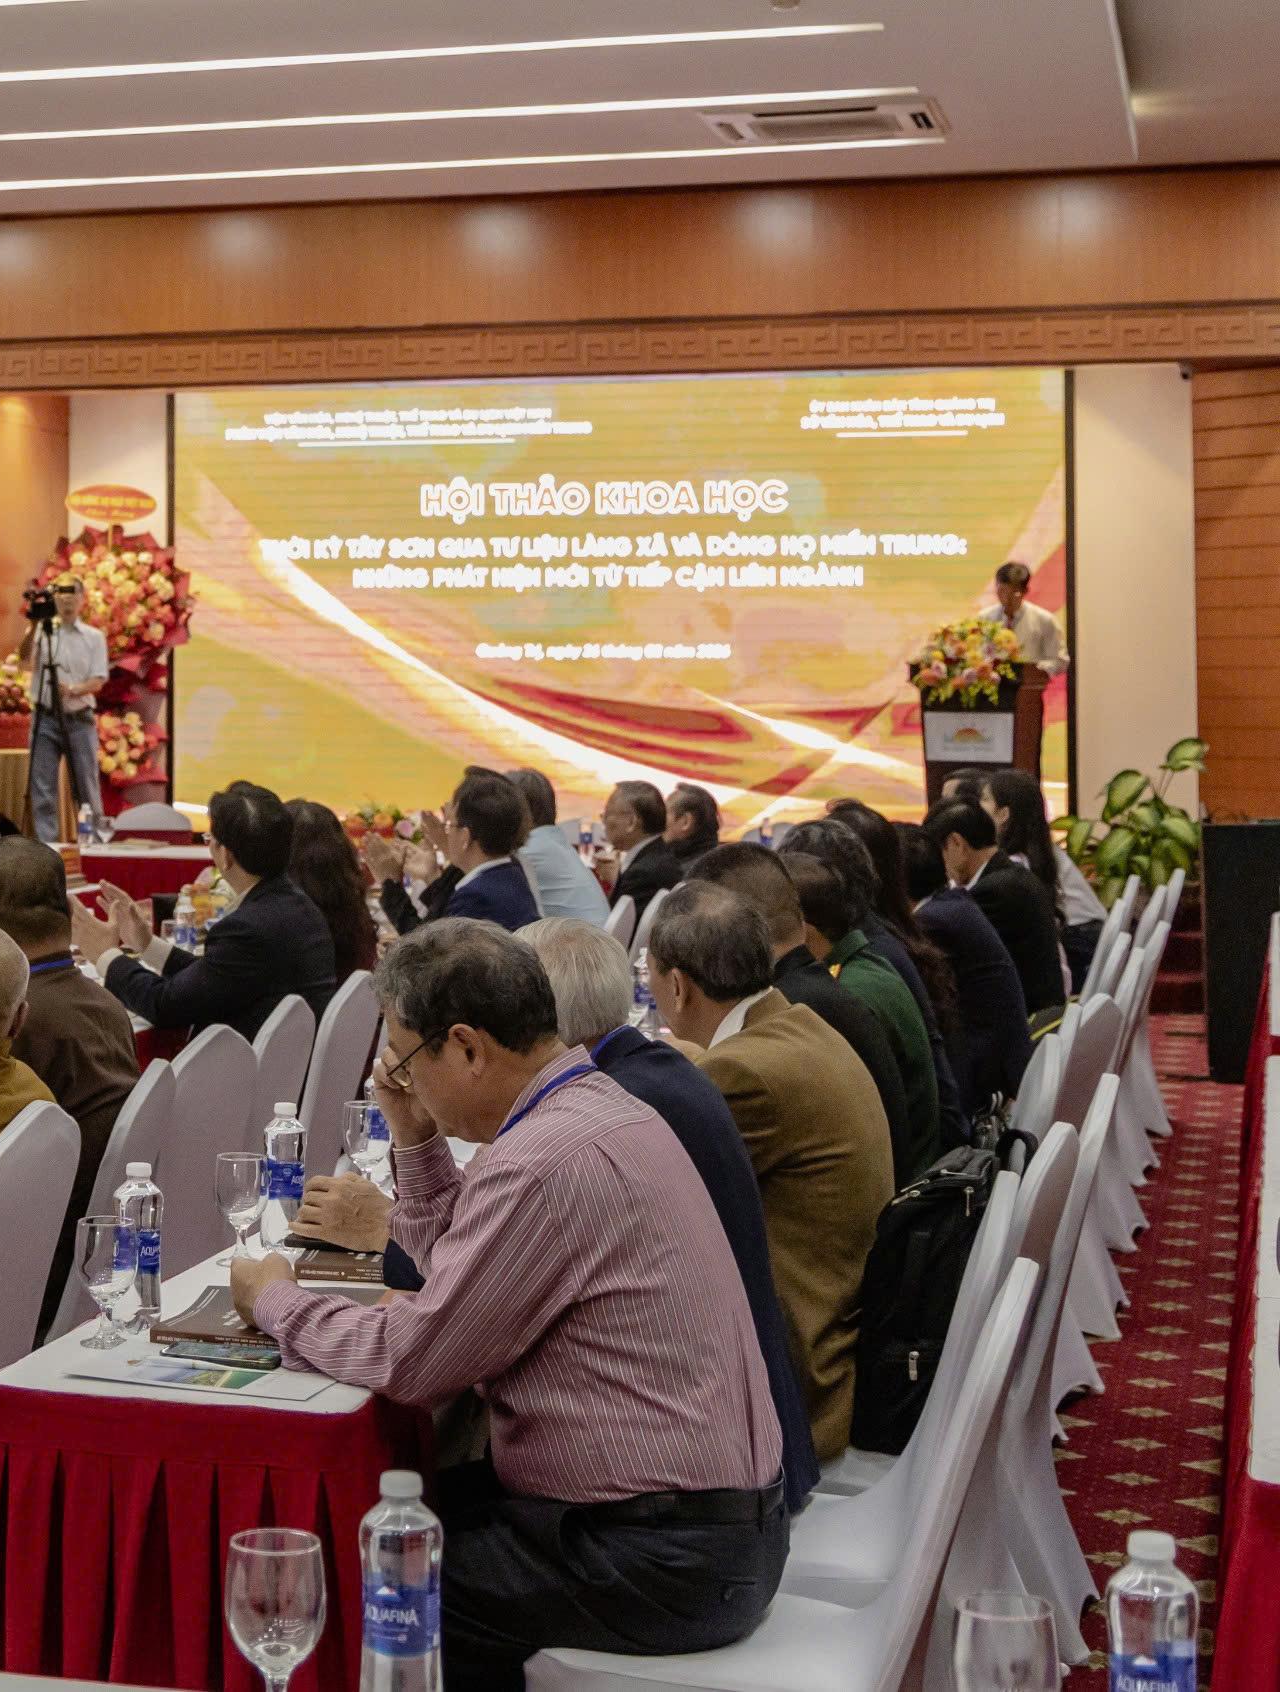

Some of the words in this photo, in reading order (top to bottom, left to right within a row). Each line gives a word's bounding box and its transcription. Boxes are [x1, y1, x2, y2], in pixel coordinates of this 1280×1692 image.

[421, 476, 484, 525] HỘI
[489, 473, 590, 516] THẢO
[595, 480, 699, 516] KHOA
[704, 479, 789, 523] HỌC
